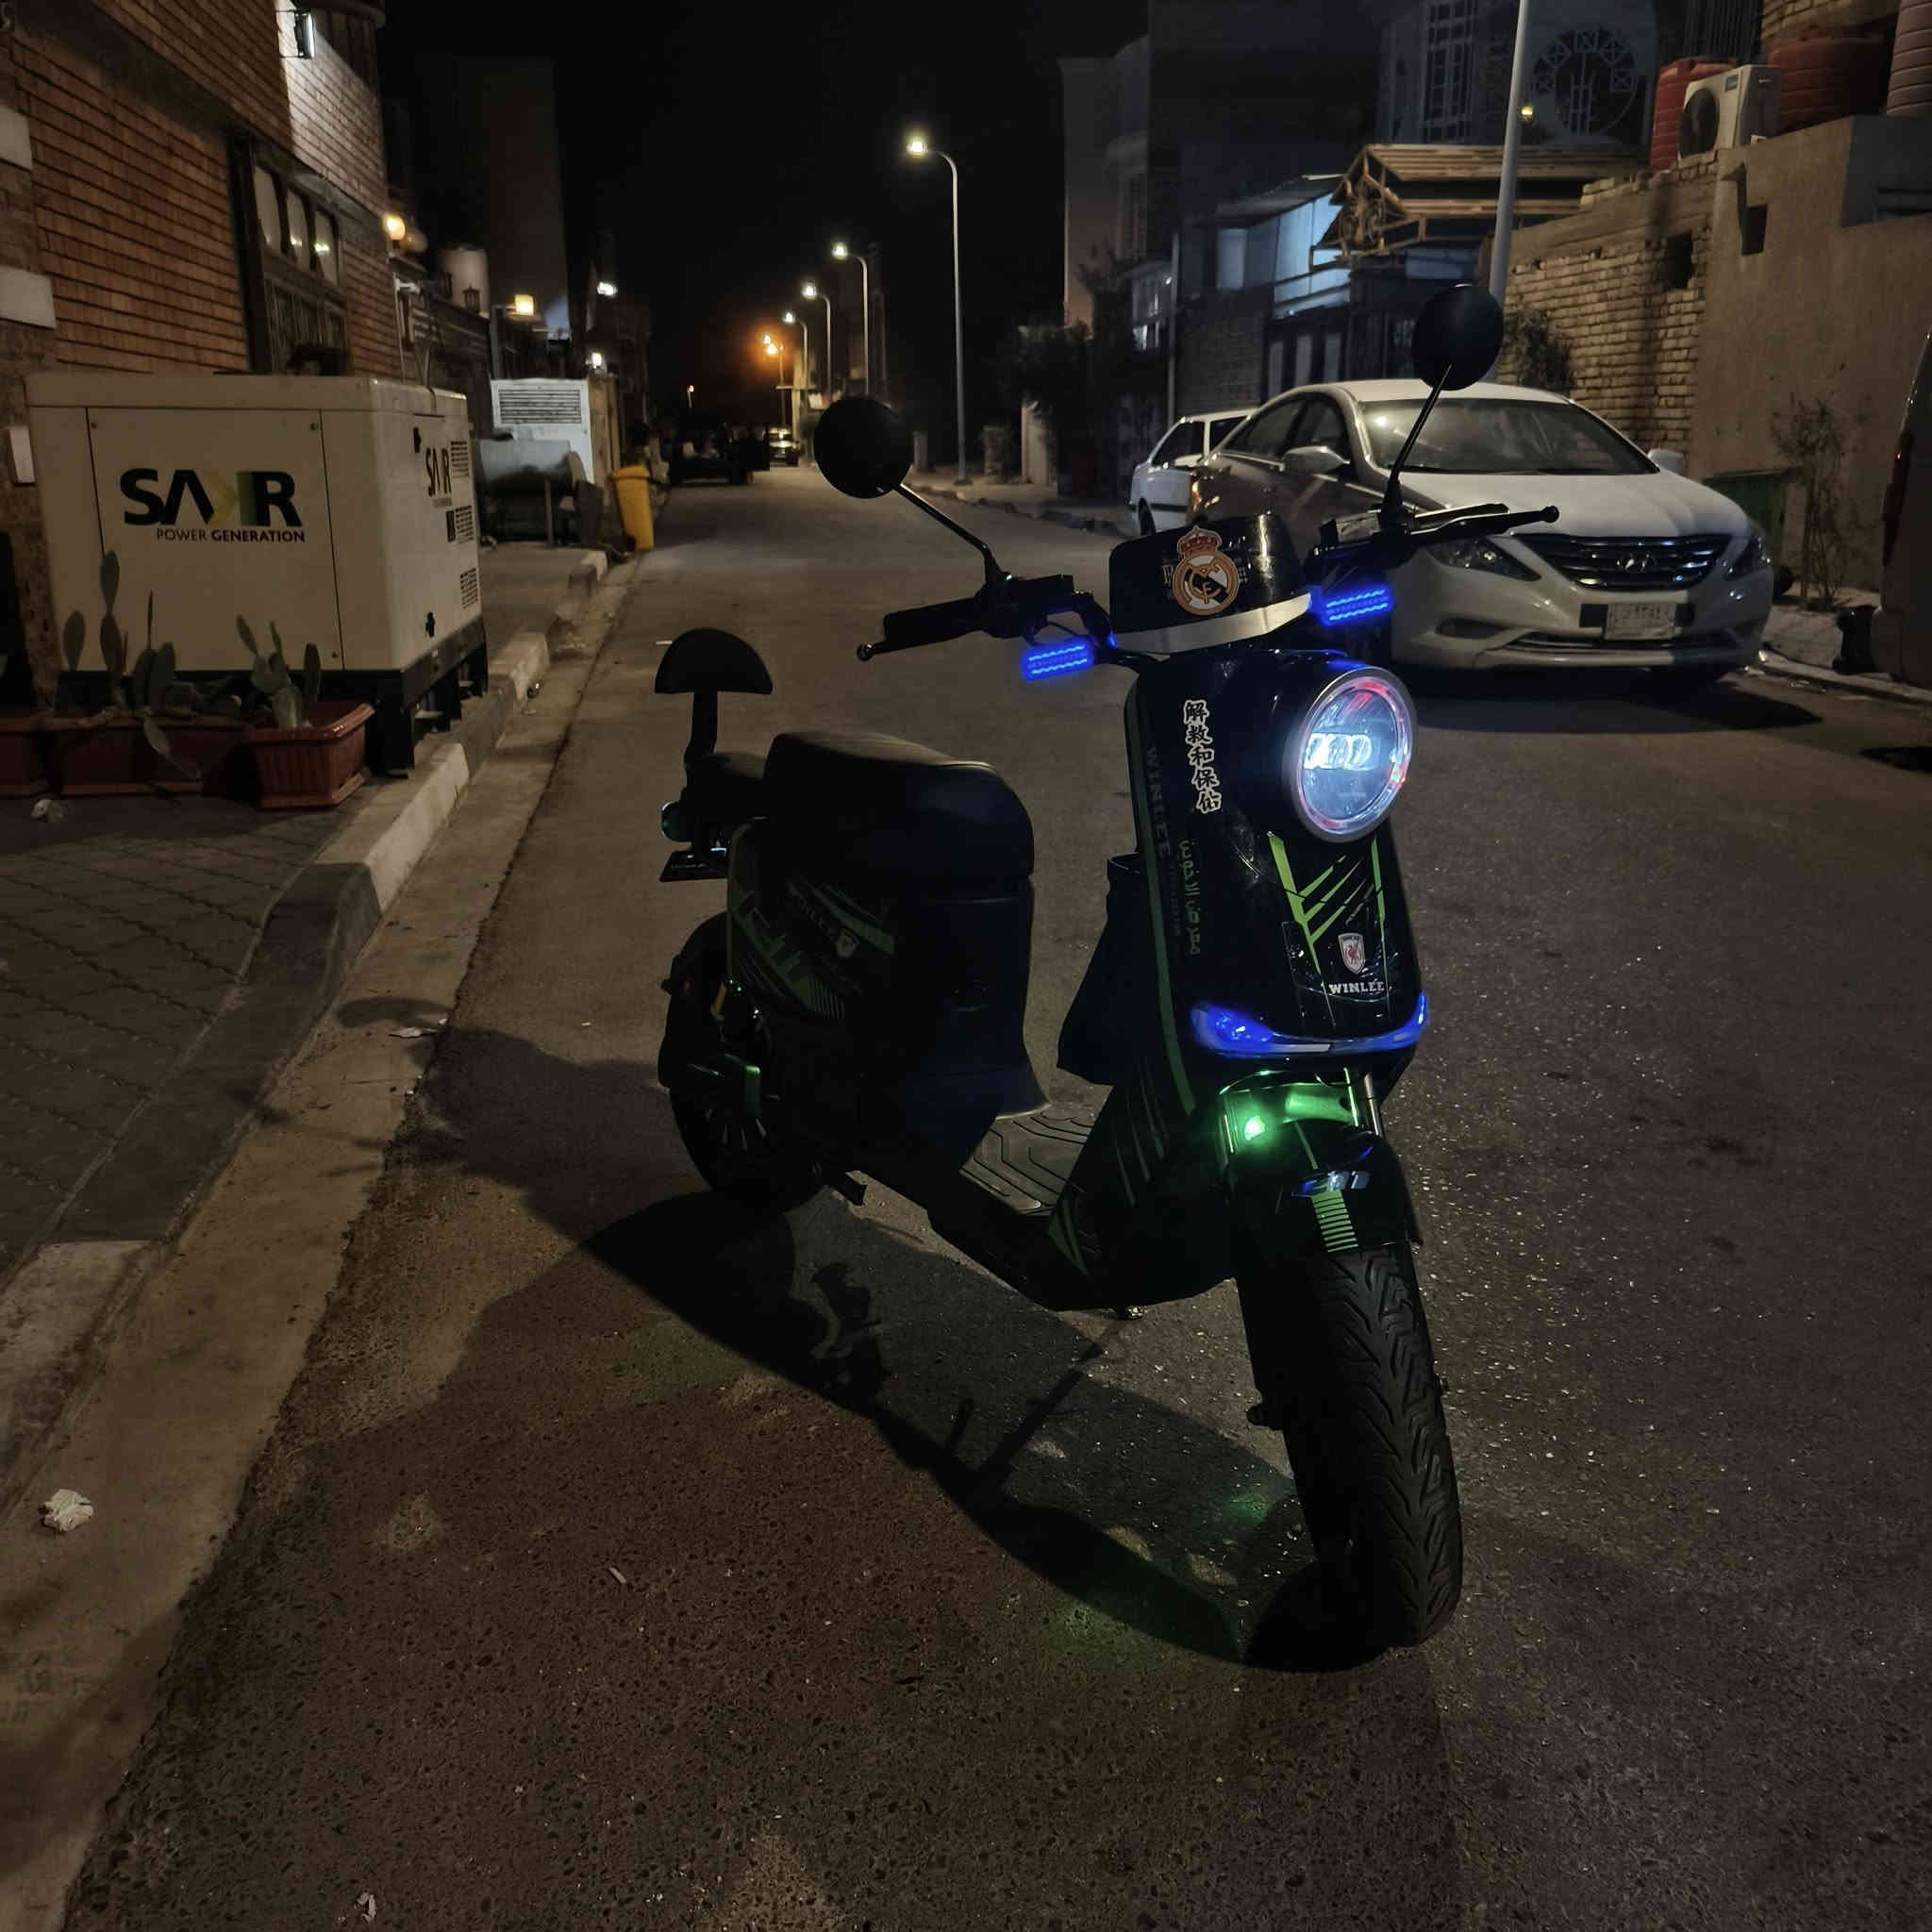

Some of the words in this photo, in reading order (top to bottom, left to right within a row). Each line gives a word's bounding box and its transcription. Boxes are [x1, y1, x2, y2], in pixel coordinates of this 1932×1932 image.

[157, 528, 207, 542] POWER
[210, 529, 306, 542] GENERATION
[1145, 745, 1171, 858] WINLEE
[1328, 981, 1385, 994] WINLEE
